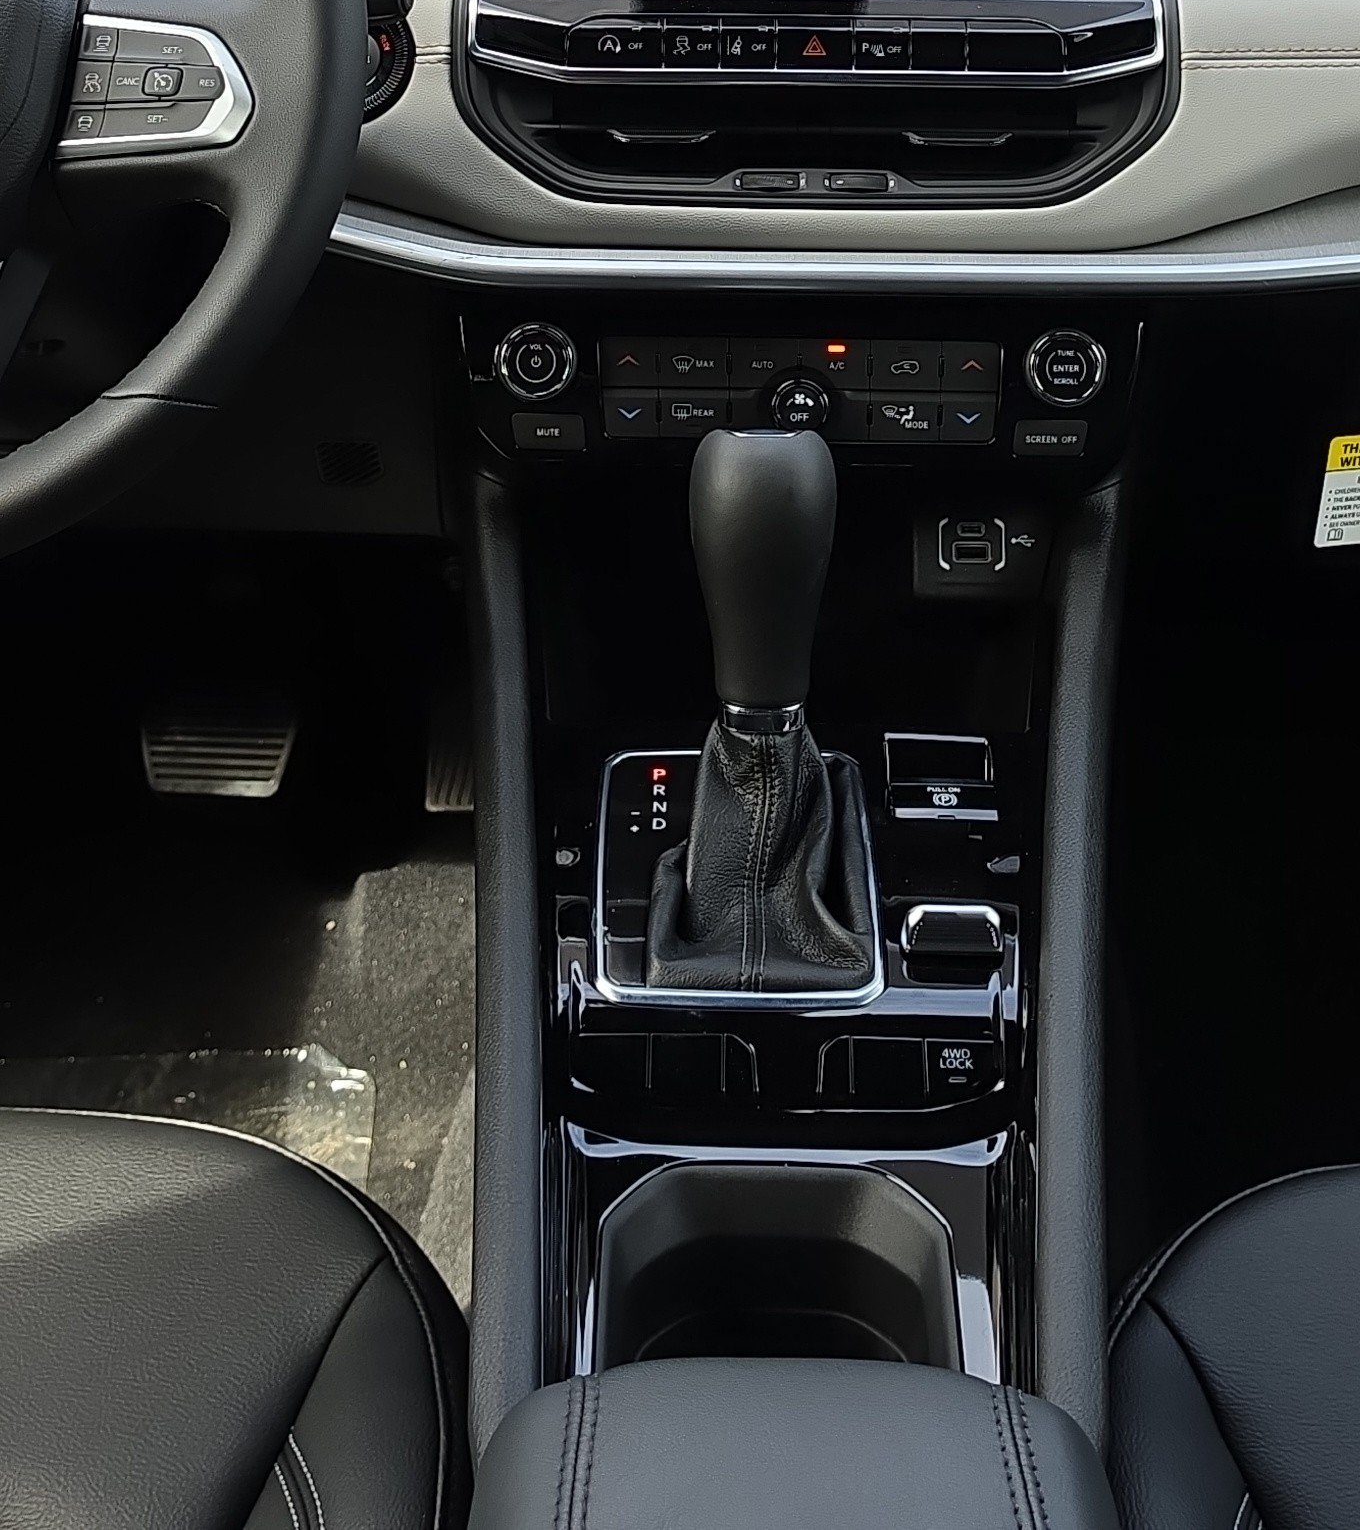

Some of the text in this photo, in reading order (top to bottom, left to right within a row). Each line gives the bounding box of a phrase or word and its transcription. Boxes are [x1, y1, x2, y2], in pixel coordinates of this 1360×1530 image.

[628, 43, 643, 51] OFF
[697, 43, 712, 51] OFF
[751, 43, 767, 52] OFF
[862, 44, 869, 53] P
[116, 77, 140, 86] CANC
[198, 79, 215, 87] RES
[529, 343, 543, 351] VOL
[696, 360, 715, 368] MAX
[751, 361, 774, 369] AUTO
[829, 361, 845, 370] A/C
[1052, 365, 1080, 373] ENTER
[693, 409, 715, 417] REAR
[789, 413, 810, 422] OFF
[904, 421, 929, 429] MODE
[536, 428, 560, 437] MUTE
[1025, 435, 1078, 443] SCREEN OFF
[1330, 512, 1355, 520] ALWAYS
[653, 768, 666, 781] P
[653, 784, 666, 796] R
[652, 801, 667, 813] N
[652, 817, 667, 830] D
[941, 1047, 971, 1059] 4WD
[939, 1057, 974, 1070] LOCK
